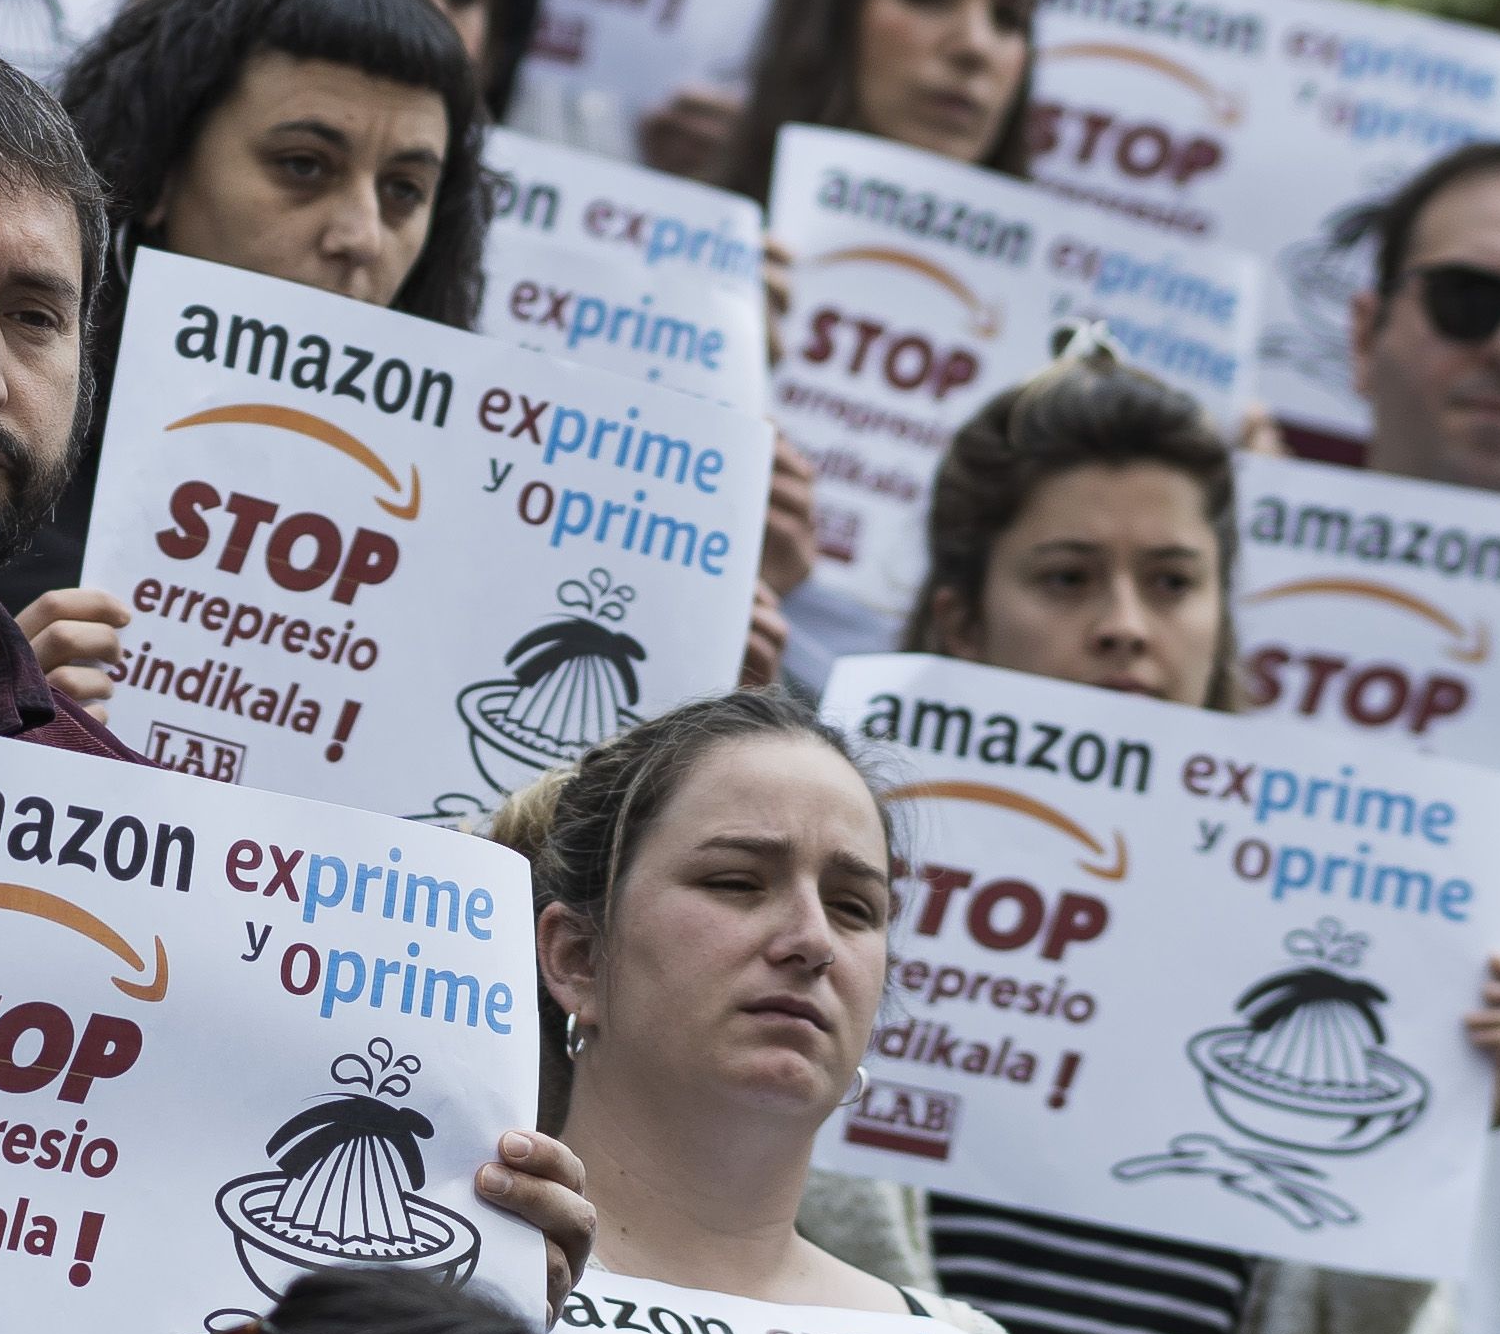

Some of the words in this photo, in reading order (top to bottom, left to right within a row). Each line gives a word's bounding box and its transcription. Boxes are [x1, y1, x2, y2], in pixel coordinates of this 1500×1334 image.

[818, 168, 1031, 265] amazon
[509, 279, 725, 369] exprime
[802, 307, 982, 400] STOP
[177, 303, 453, 426] amazon
[478, 387, 725, 492] exprime
[154, 480, 400, 605] STOP
[482, 458, 513, 492] y
[517, 460, 734, 574] oprime
[132, 578, 380, 671] errepresio
[1240, 642, 1472, 742] STOP
[861, 690, 1153, 794] amazon
[1182, 754, 1453, 841] exprime
[224, 835, 496, 944] exprime
[1196, 815, 1227, 853] y
[1232, 819, 1472, 921] oprime
[241, 921, 273, 965] y
[280, 937, 514, 1035] oprime
